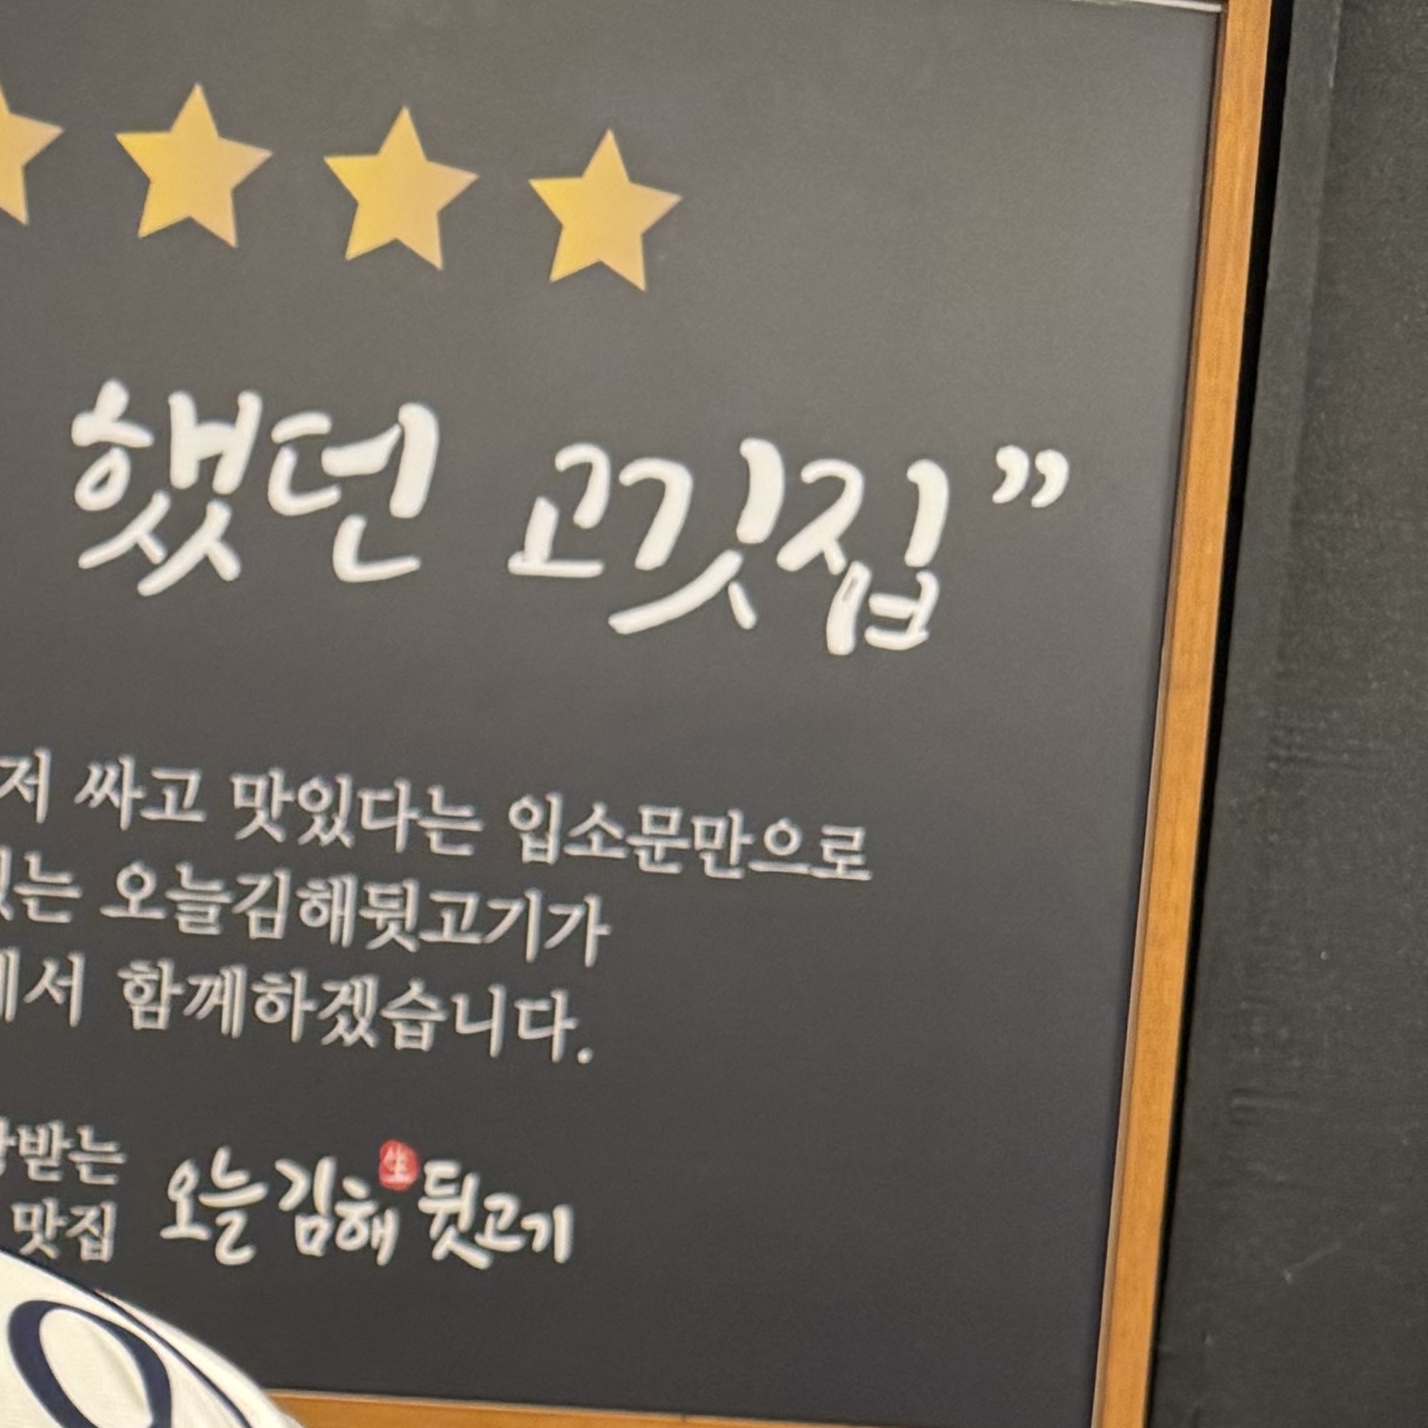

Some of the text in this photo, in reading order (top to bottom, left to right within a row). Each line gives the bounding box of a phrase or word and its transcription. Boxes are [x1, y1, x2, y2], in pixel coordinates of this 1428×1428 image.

[508, 438, 1070, 656] 고깃집”
[75, 756, 205, 830] 싸고
[231, 768, 482, 856] 맛있다는
[508, 793, 871, 881] 입소문만으로
[100, 862, 611, 968] 오늘김해뒷고기가
[117, 957, 595, 1065] 함께하겠습니다.
[10, 1198, 117, 1263] 맛집
